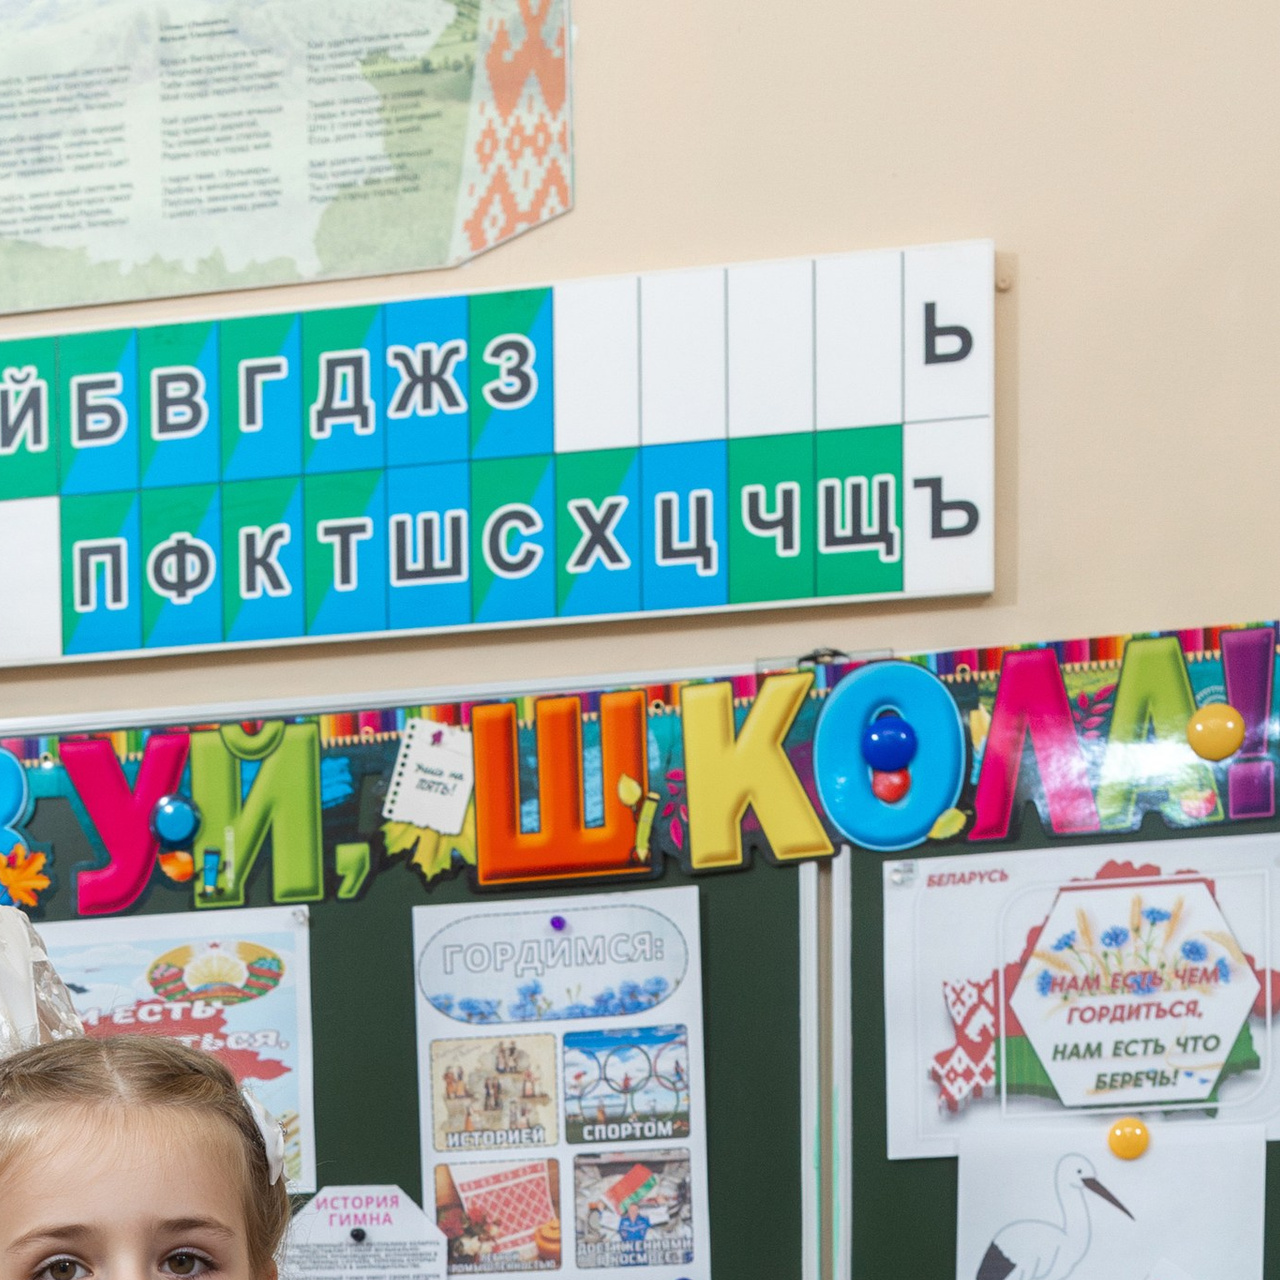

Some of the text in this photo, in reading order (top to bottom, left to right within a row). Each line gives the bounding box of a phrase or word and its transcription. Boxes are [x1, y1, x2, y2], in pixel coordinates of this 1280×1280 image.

[75, 378, 122, 443] Б
[155, 371, 204, 435] В
[241, 361, 285, 429] Г
[314, 354, 371, 434] Д
[391, 344, 462, 414] Ж
[488, 338, 535, 405] З
[922, 300, 975, 367] Ь
[78, 543, 124, 608] П
[151, 537, 211, 600] Ф
[243, 528, 289, 595] К
[320, 521, 370, 588] Т
[394, 514, 464, 583] Ш
[487, 508, 541, 574] С
[572, 501, 627, 569] Х
[659, 494, 714, 572] Ц
[746, 486, 798, 552] Ч
[822, 479, 898, 560] Щ
[911, 475, 981, 541] Ъ
[472, 627, 1275, 885] ШКОЛА!
[926, 869, 1010, 888] БЕЛАРУСЬ
[442, 930, 665, 978] ГОРДИМСЯ:
[1050, 966, 1220, 993] НАМ ЕСТЬ ЧЕМ
[112, 1000, 218, 1024] ЕСТЬ
[1052, 1034, 1220, 1061] НАМ ЕСТЬ ЧТО
[1094, 1070, 1180, 1091] БЕРЕЧЬ!
[446, 1127, 546, 1148] ИСТОРИЕЙ
[582, 1121, 673, 1141] СПОРТОМ
[315, 1195, 400, 1210] ИСТОРИЯ
[328, 1213, 394, 1227] ГИМНА
